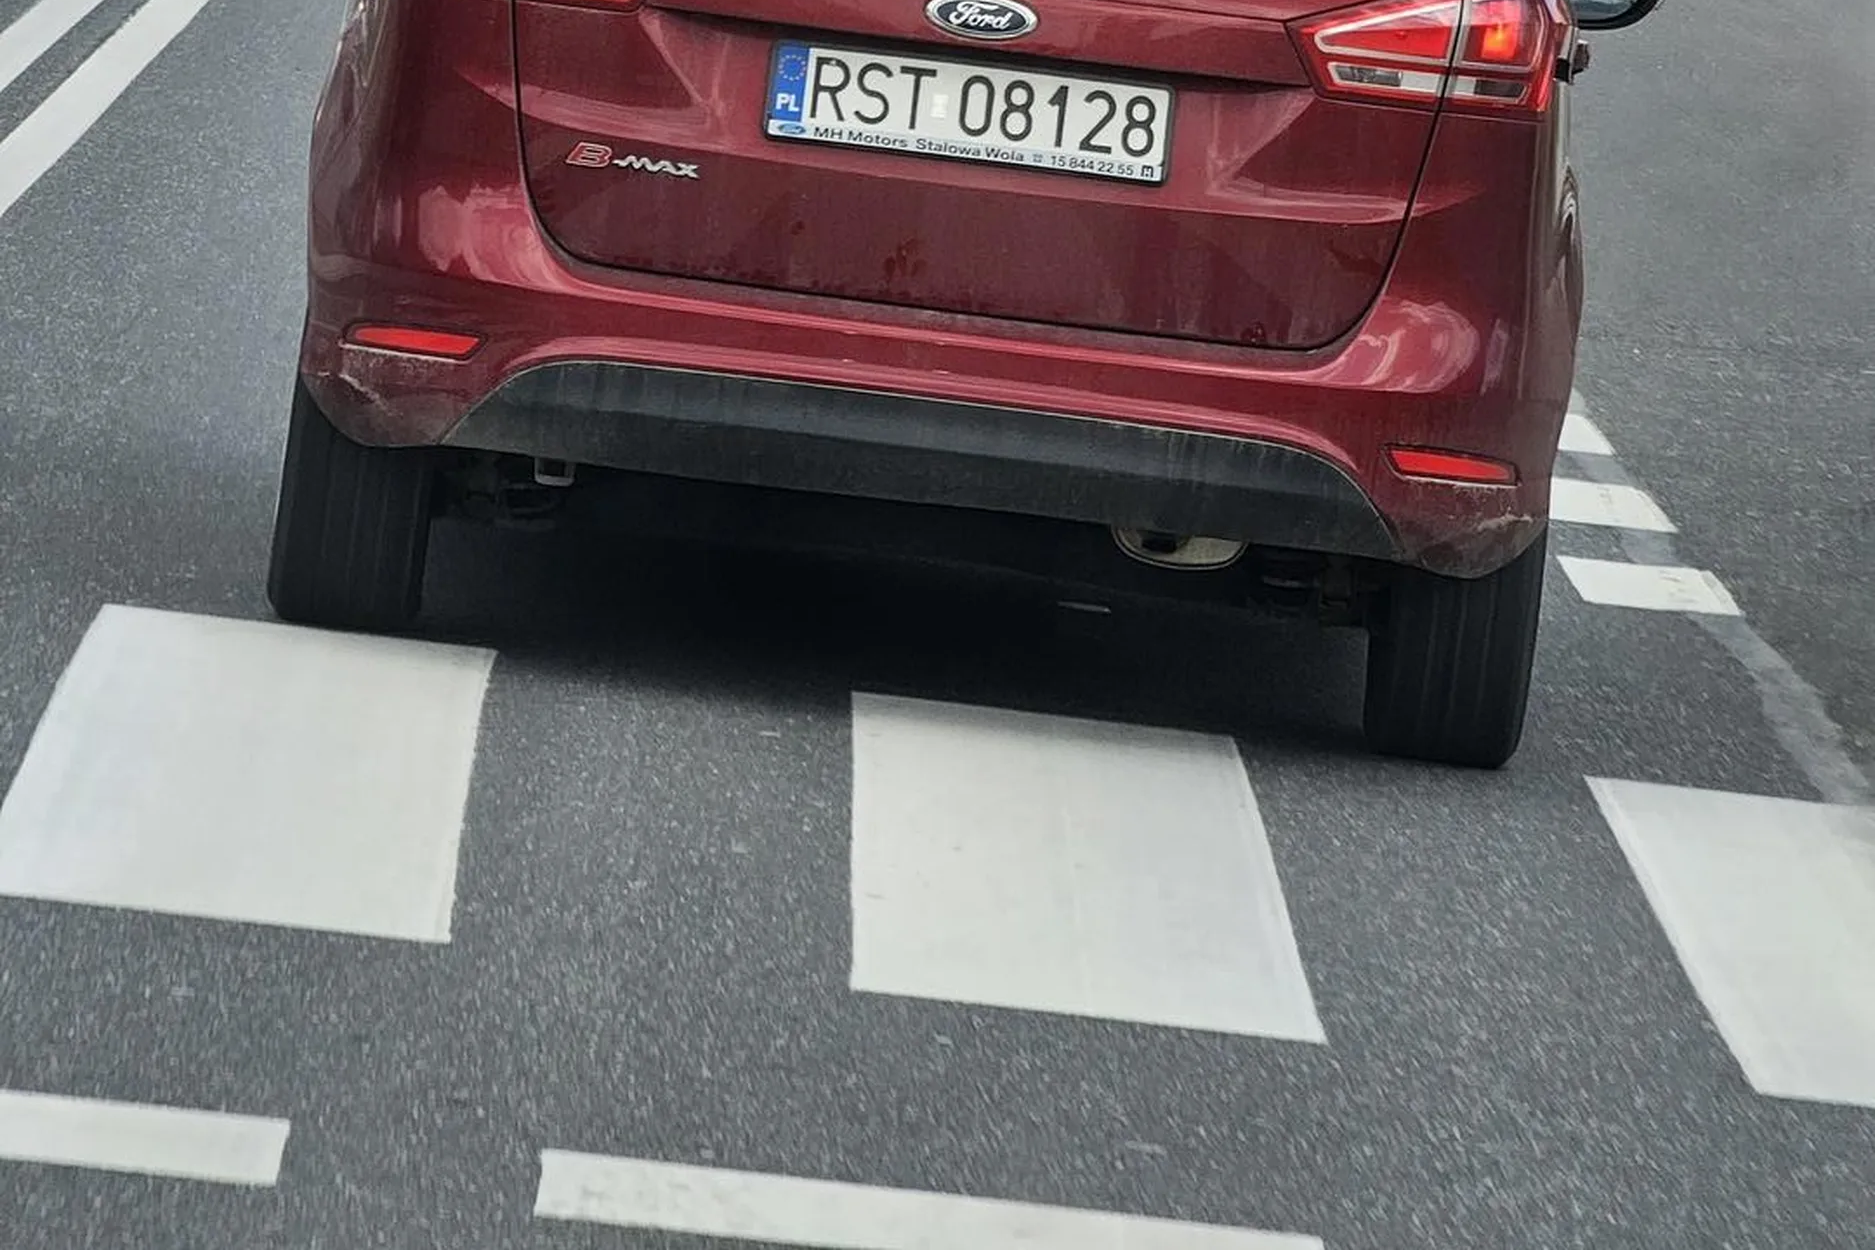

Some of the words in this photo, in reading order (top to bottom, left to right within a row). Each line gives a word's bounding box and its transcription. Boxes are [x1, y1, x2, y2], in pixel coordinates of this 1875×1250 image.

[948, 1, 1014, 30] Ford
[775, 93, 800, 112] PL
[809, 56, 938, 130] RST
[958, 74, 1157, 158] 08128
[813, 126, 843, 141] MH
[847, 129, 908, 149] Motors
[915, 138, 981, 156] Stalowa
[984, 146, 1025, 162] Wola
